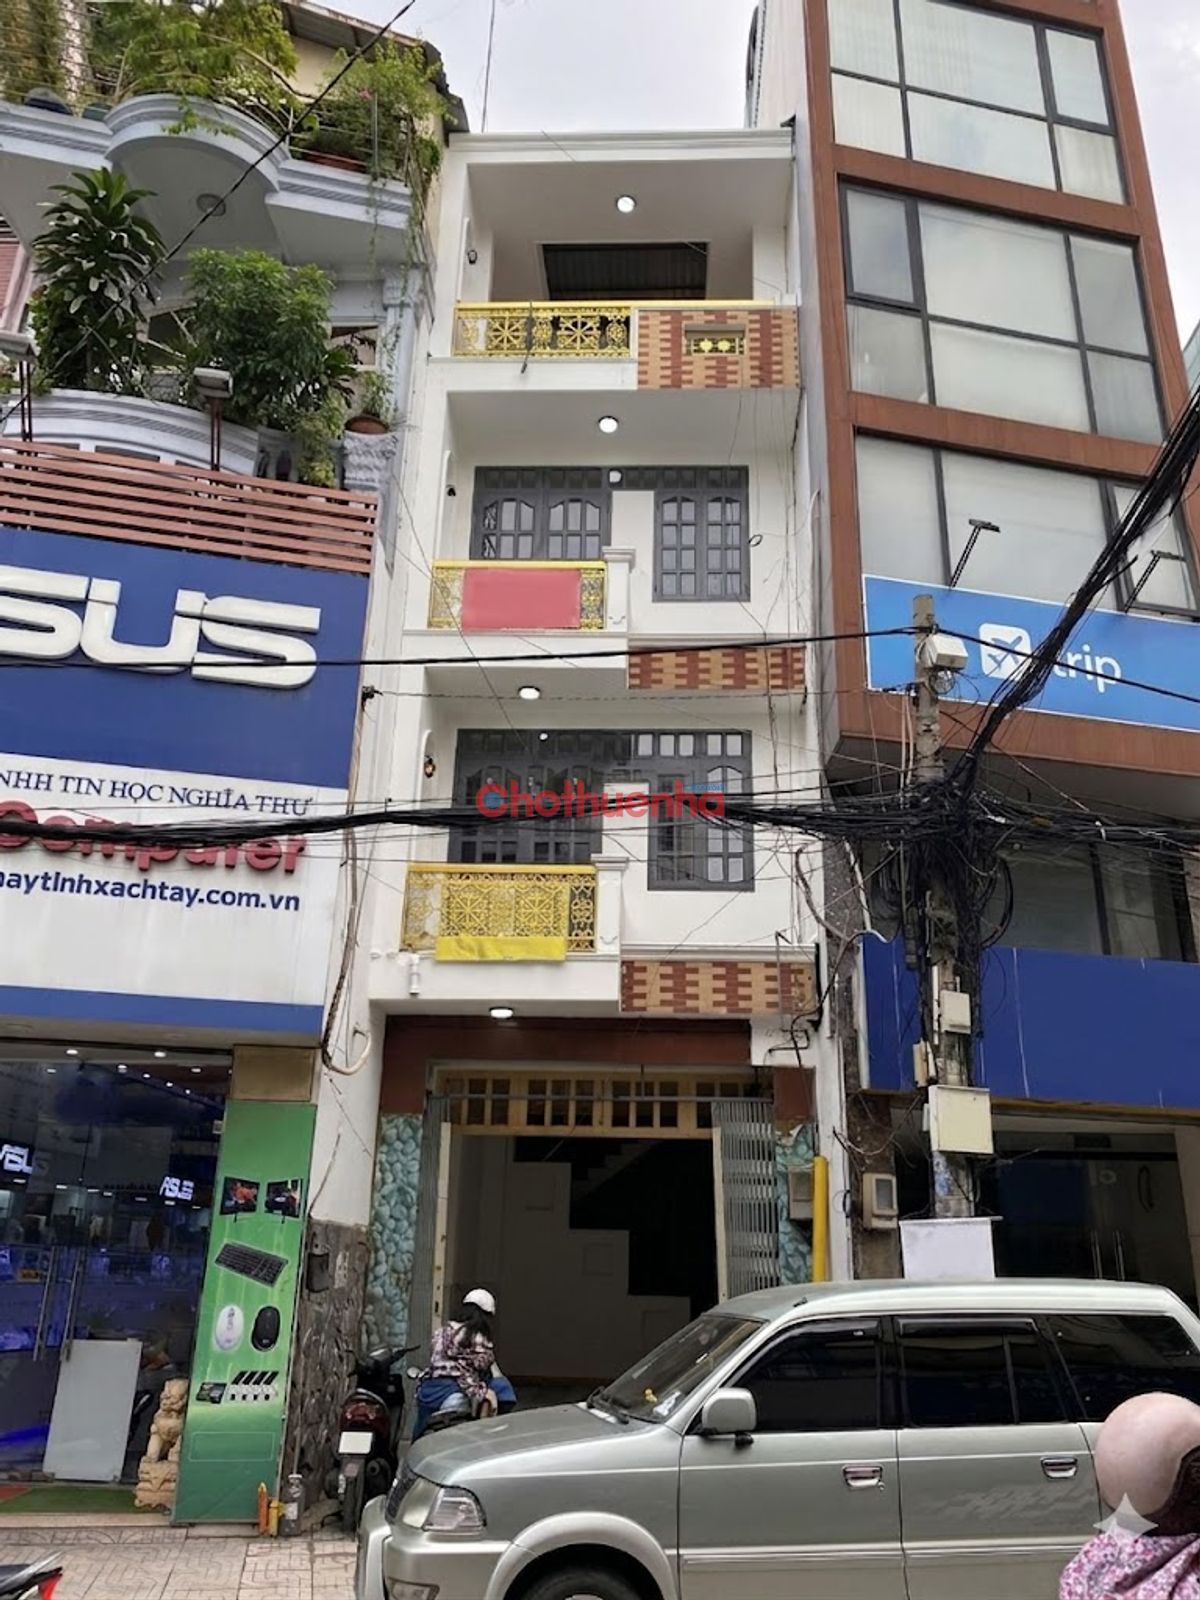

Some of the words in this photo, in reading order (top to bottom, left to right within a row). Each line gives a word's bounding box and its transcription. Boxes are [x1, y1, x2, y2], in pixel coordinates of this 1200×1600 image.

[58, 774, 104, 797] TIN
[108, 781, 165, 803] HỌC
[168, 787, 251, 811] NGHĨA
[254, 794, 314, 816] THƯ
